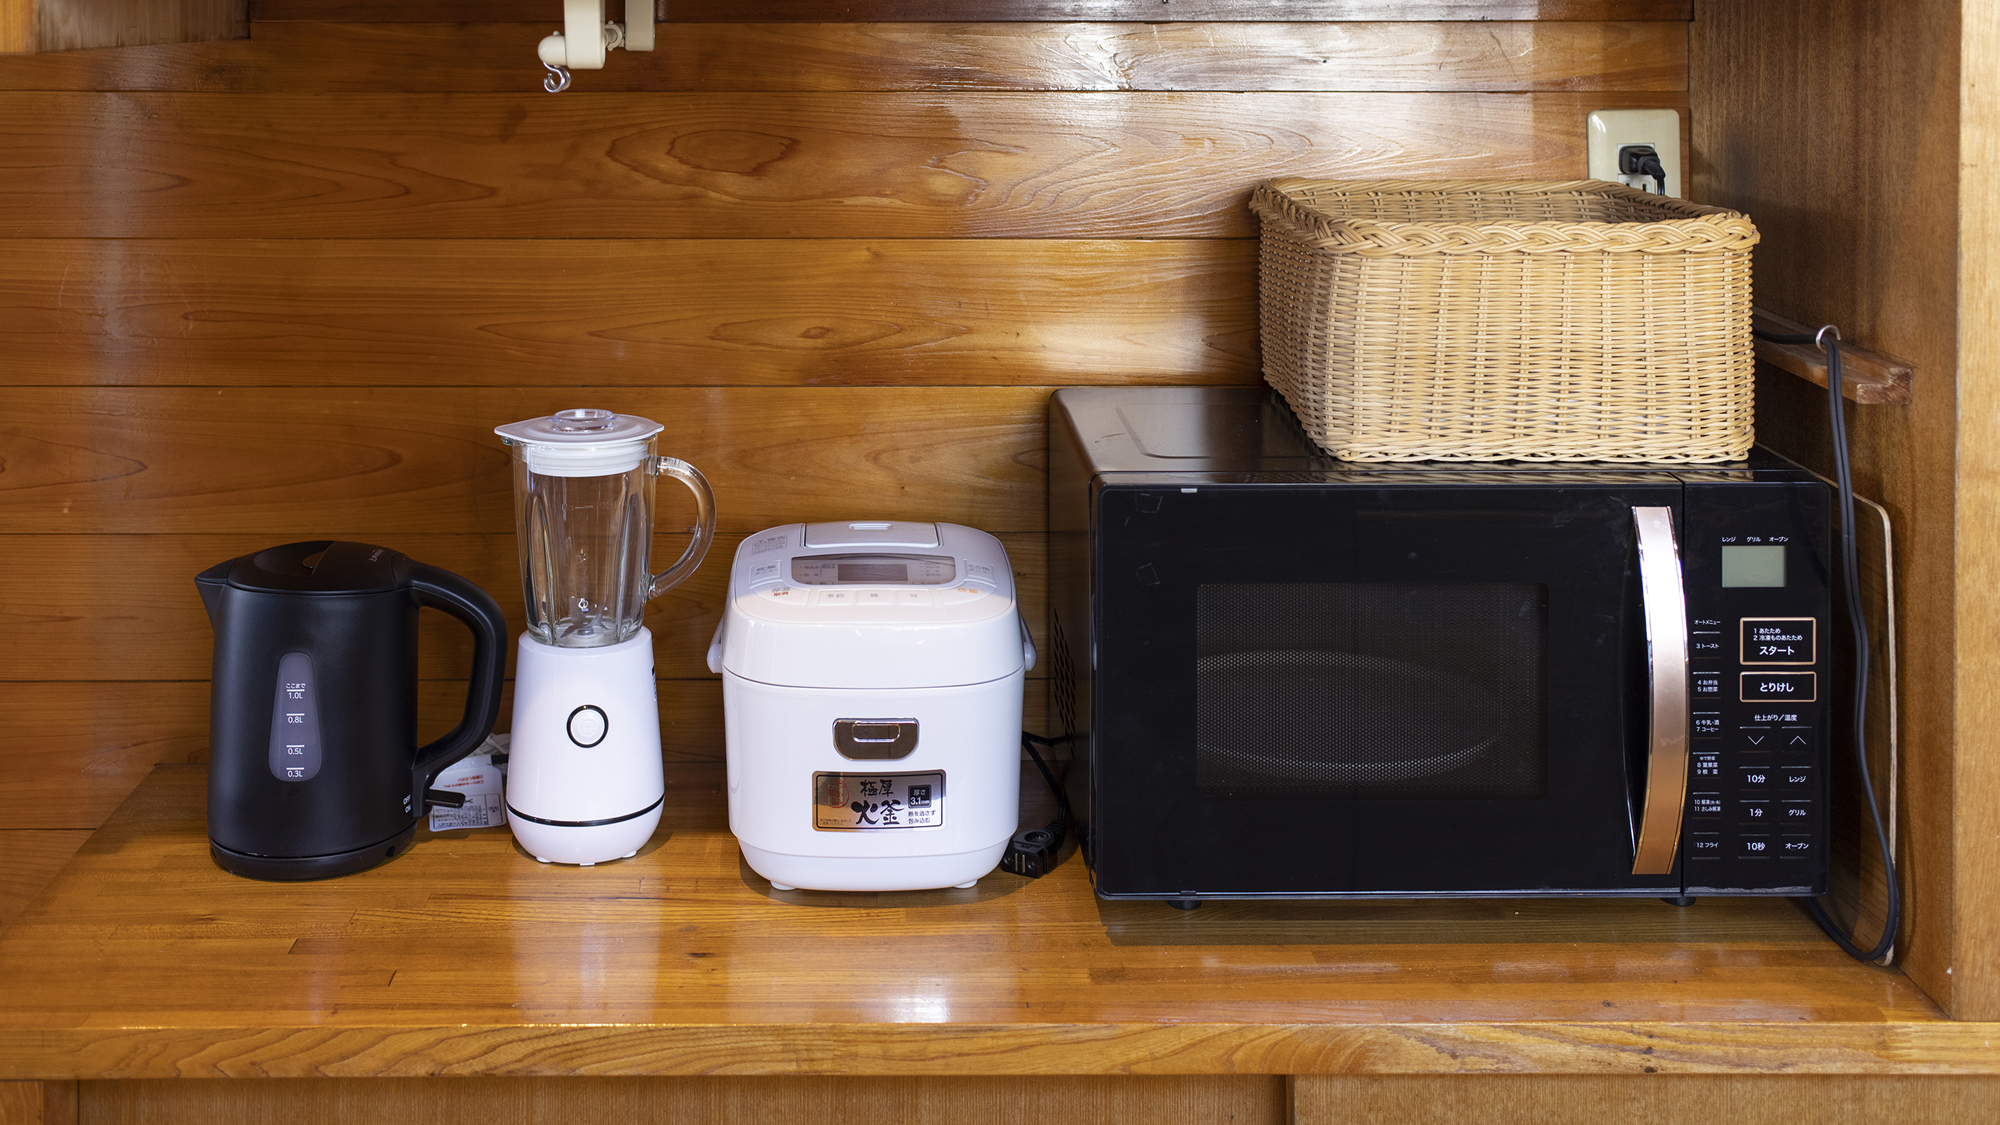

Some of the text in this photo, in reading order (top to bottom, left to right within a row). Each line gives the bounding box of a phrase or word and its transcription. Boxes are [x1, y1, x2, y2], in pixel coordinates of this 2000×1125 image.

[1759, 645, 1795, 655] スタート
[1759, 682, 1795, 693] とりけし
[287, 716, 304, 724] 0.8L
[287, 747, 304, 755] 0.5L
[287, 770, 304, 778] 0.3L
[1747, 774, 1766, 783] 10分
[1788, 775, 1807, 783] レンジ
[860, 779, 894, 797] 極厚
[851, 799, 905, 825] 火釜
[1749, 808, 1763, 817] 1分
[1747, 842, 1766, 851] 10秒
[1785, 842, 1809, 850] オーブン
